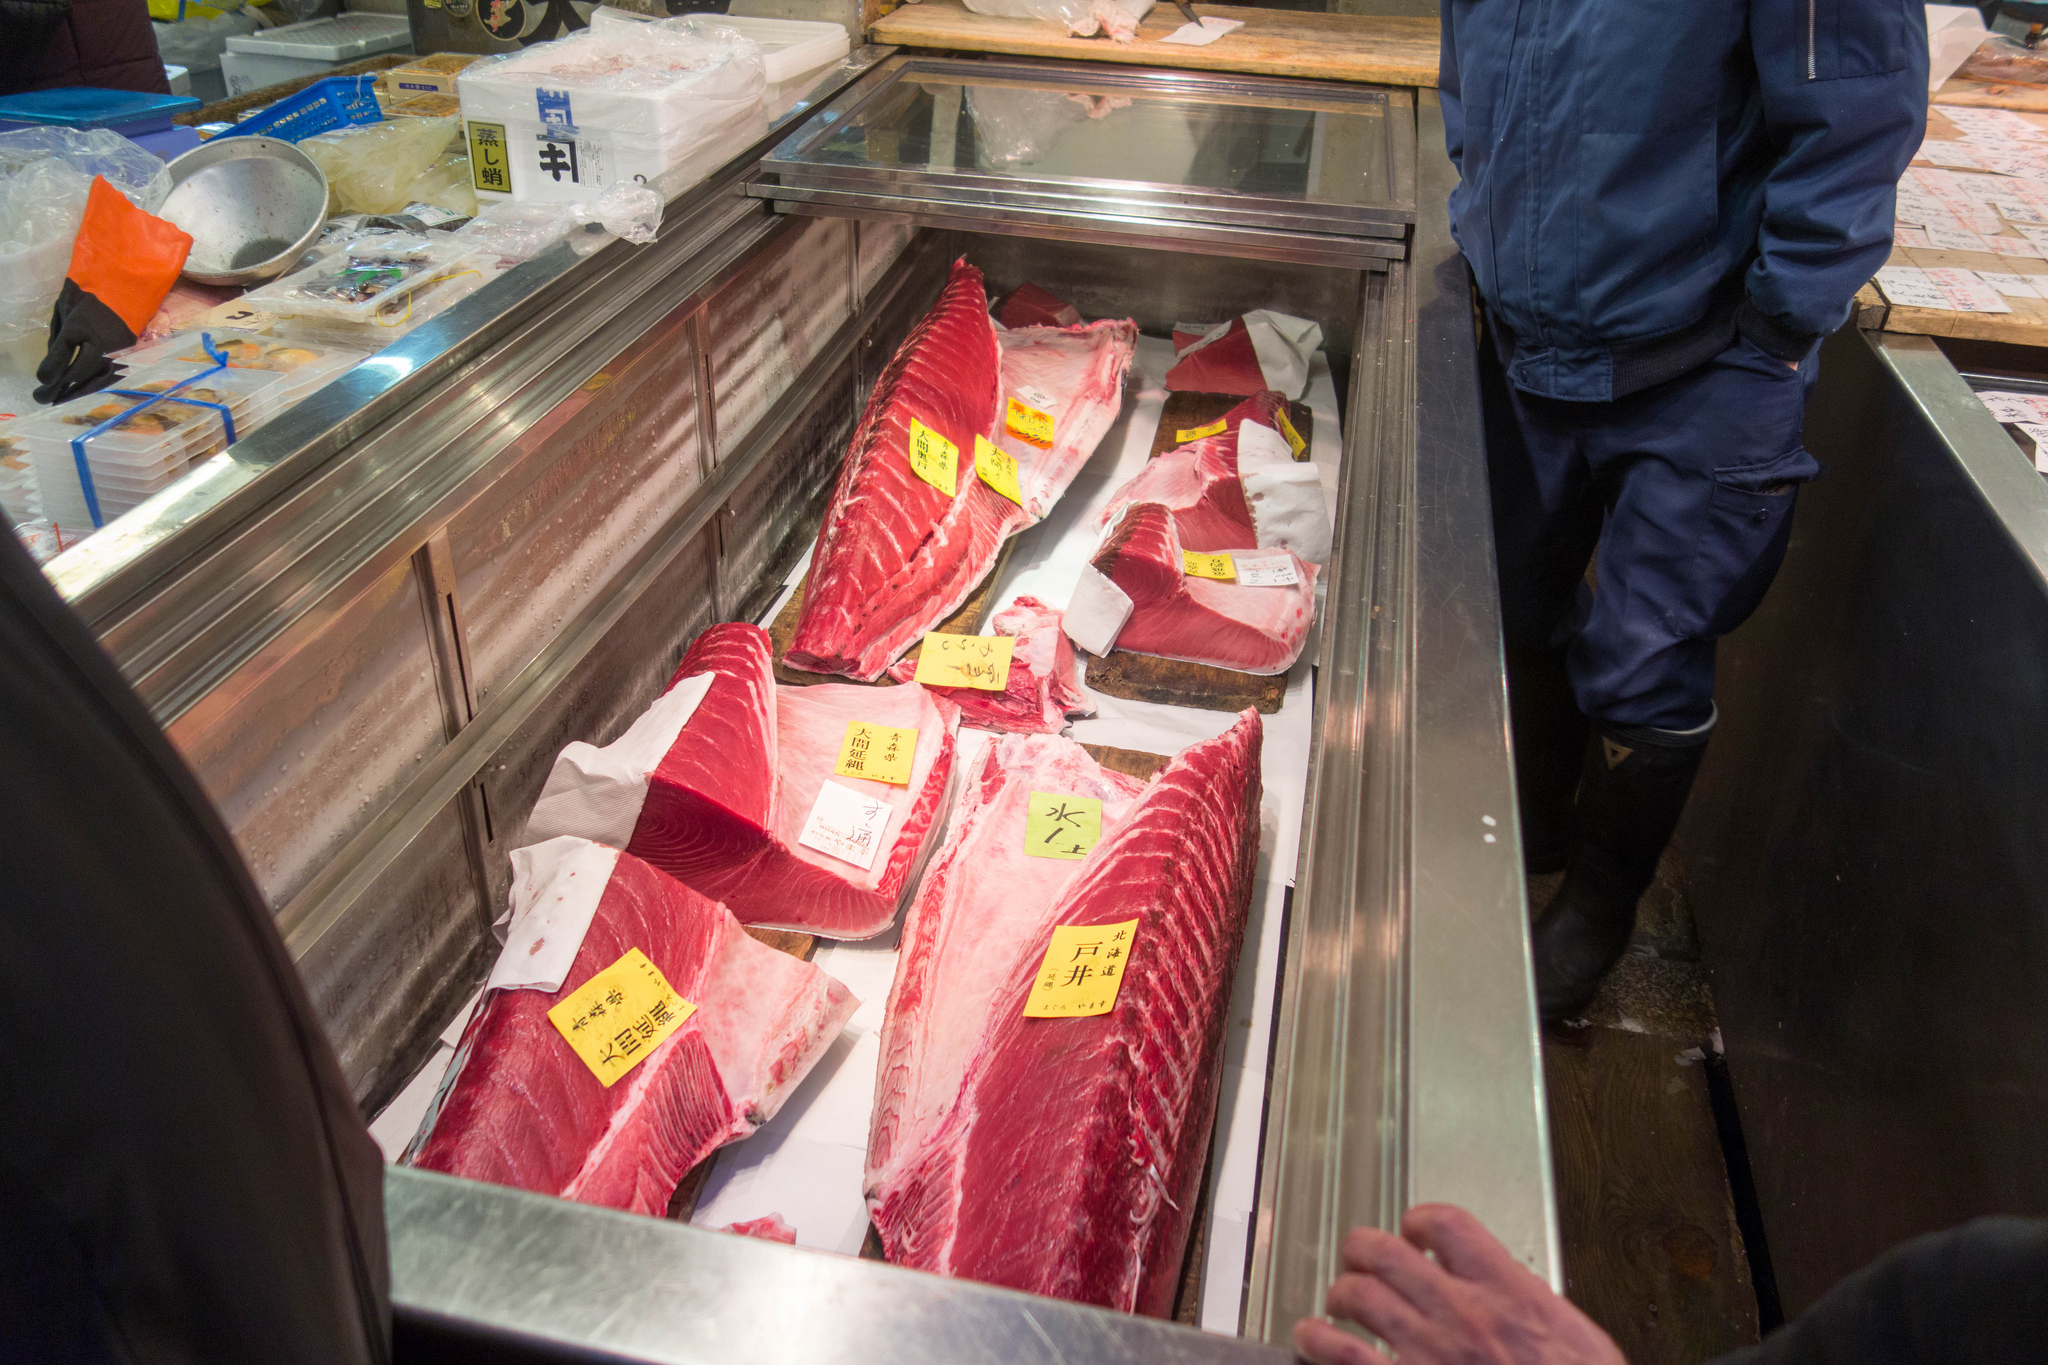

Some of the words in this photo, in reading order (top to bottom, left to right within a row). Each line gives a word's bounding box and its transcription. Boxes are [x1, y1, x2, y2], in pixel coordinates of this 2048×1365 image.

[476, 127, 503, 186] 蒸し蛸
[883, 732, 903, 762] 青森県
[1045, 803, 1086, 828] 水
[1060, 941, 1104, 987] 戸井
[1099, 929, 1127, 978] 北海道
[600, 1000, 677, 1068] 大間延縄
